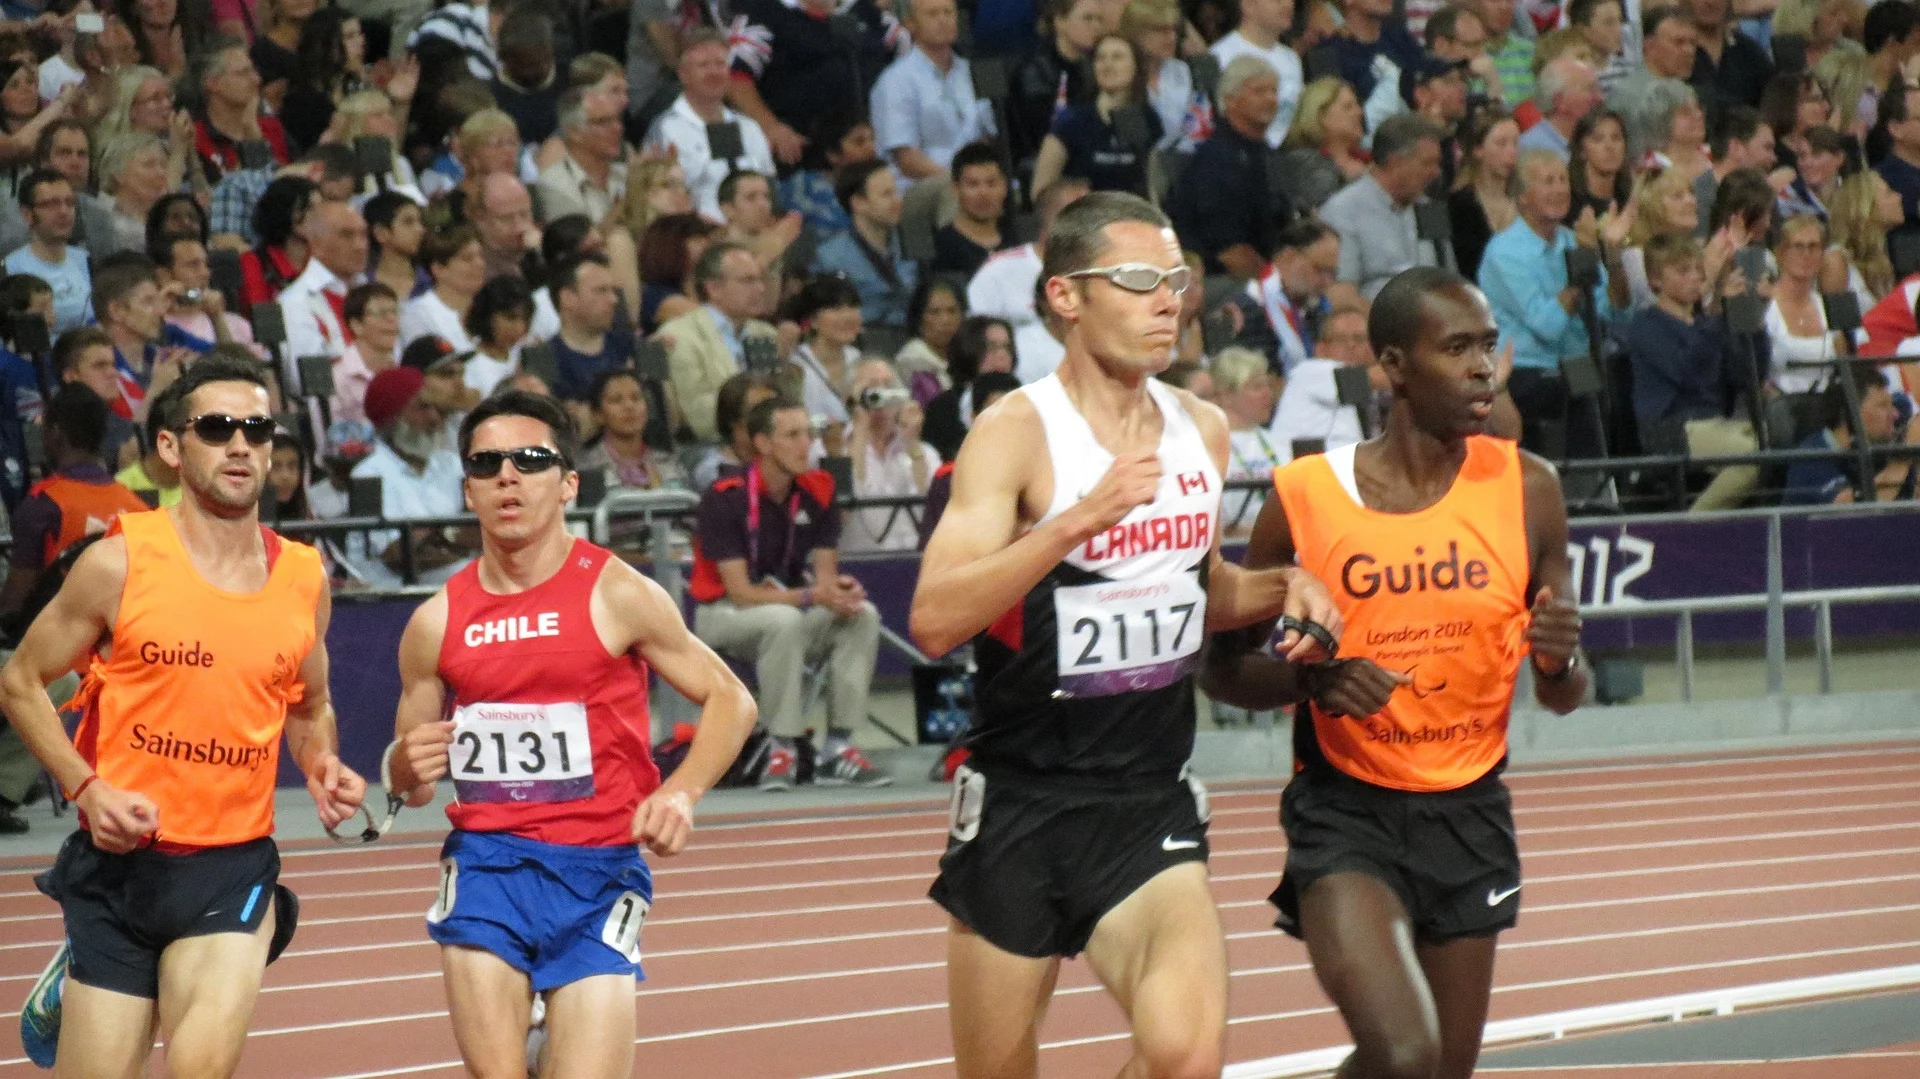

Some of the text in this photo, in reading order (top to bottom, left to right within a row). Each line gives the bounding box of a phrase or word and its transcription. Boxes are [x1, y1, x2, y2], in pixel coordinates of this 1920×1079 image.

[1083, 512, 1209, 561] CANADA
[1341, 540, 1490, 599] Guide
[464, 612, 560, 647] CHILE
[1073, 601, 1199, 667] 2117
[1366, 620, 1473, 646] London 2012
[140, 640, 214, 668] Guide
[478, 710, 545, 723] Sainsbury's
[1366, 718, 1485, 745] Sainsbury's
[130, 723, 269, 771] Sainsburys
[457, 731, 571, 775] 2131
